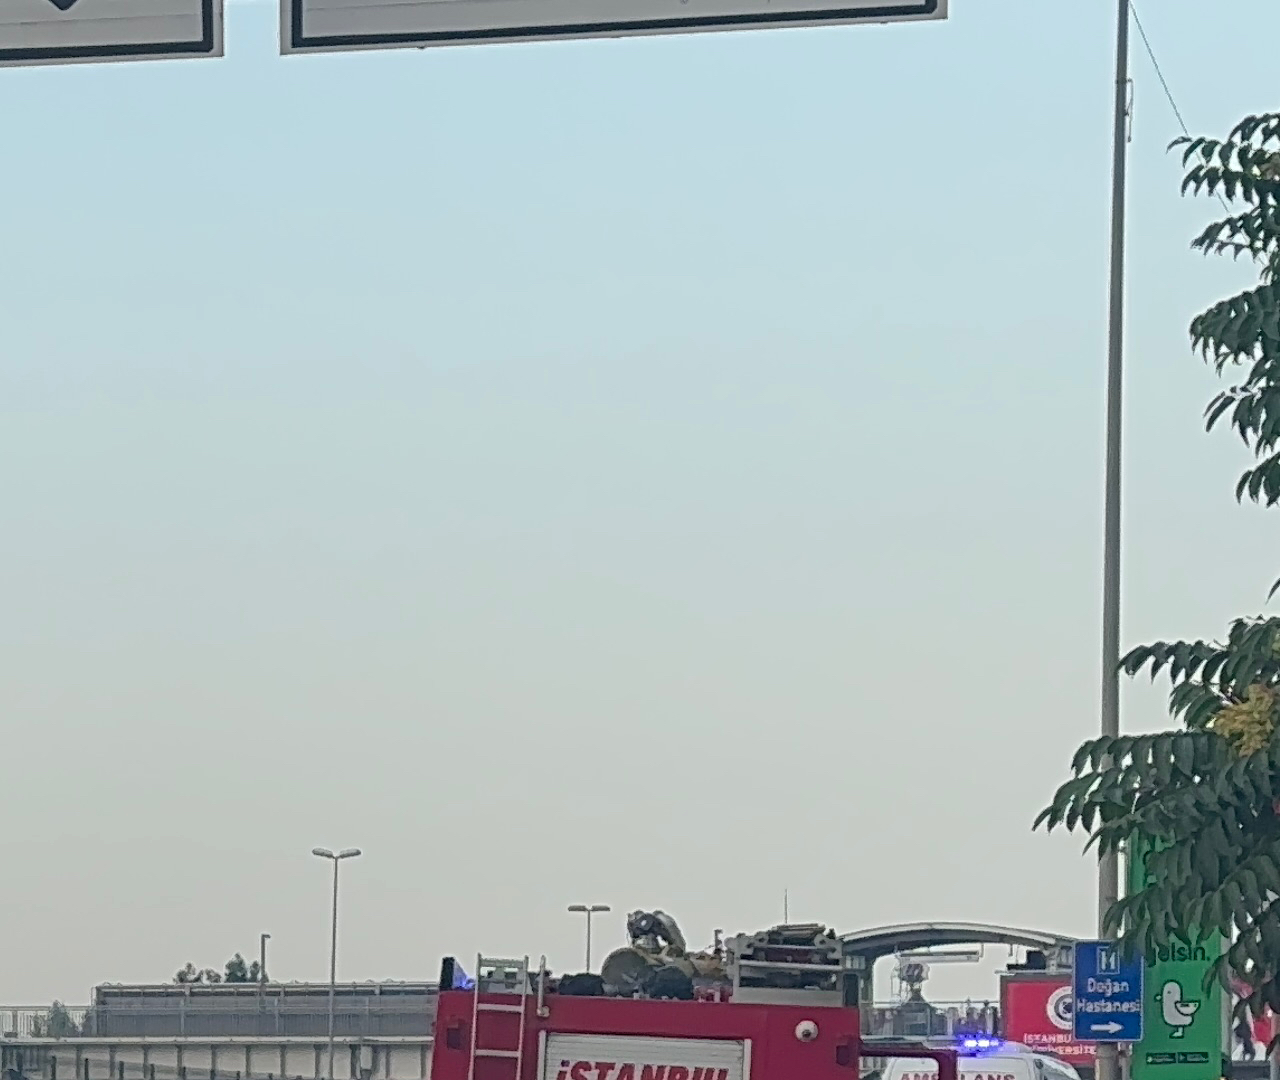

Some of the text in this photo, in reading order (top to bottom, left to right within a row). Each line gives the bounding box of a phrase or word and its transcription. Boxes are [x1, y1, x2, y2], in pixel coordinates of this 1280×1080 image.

[1087, 977, 1130, 997] Doğan
[1077, 999, 1141, 1013] Hastanesi
[1023, 1032, 1072, 1044] İSTANBU
